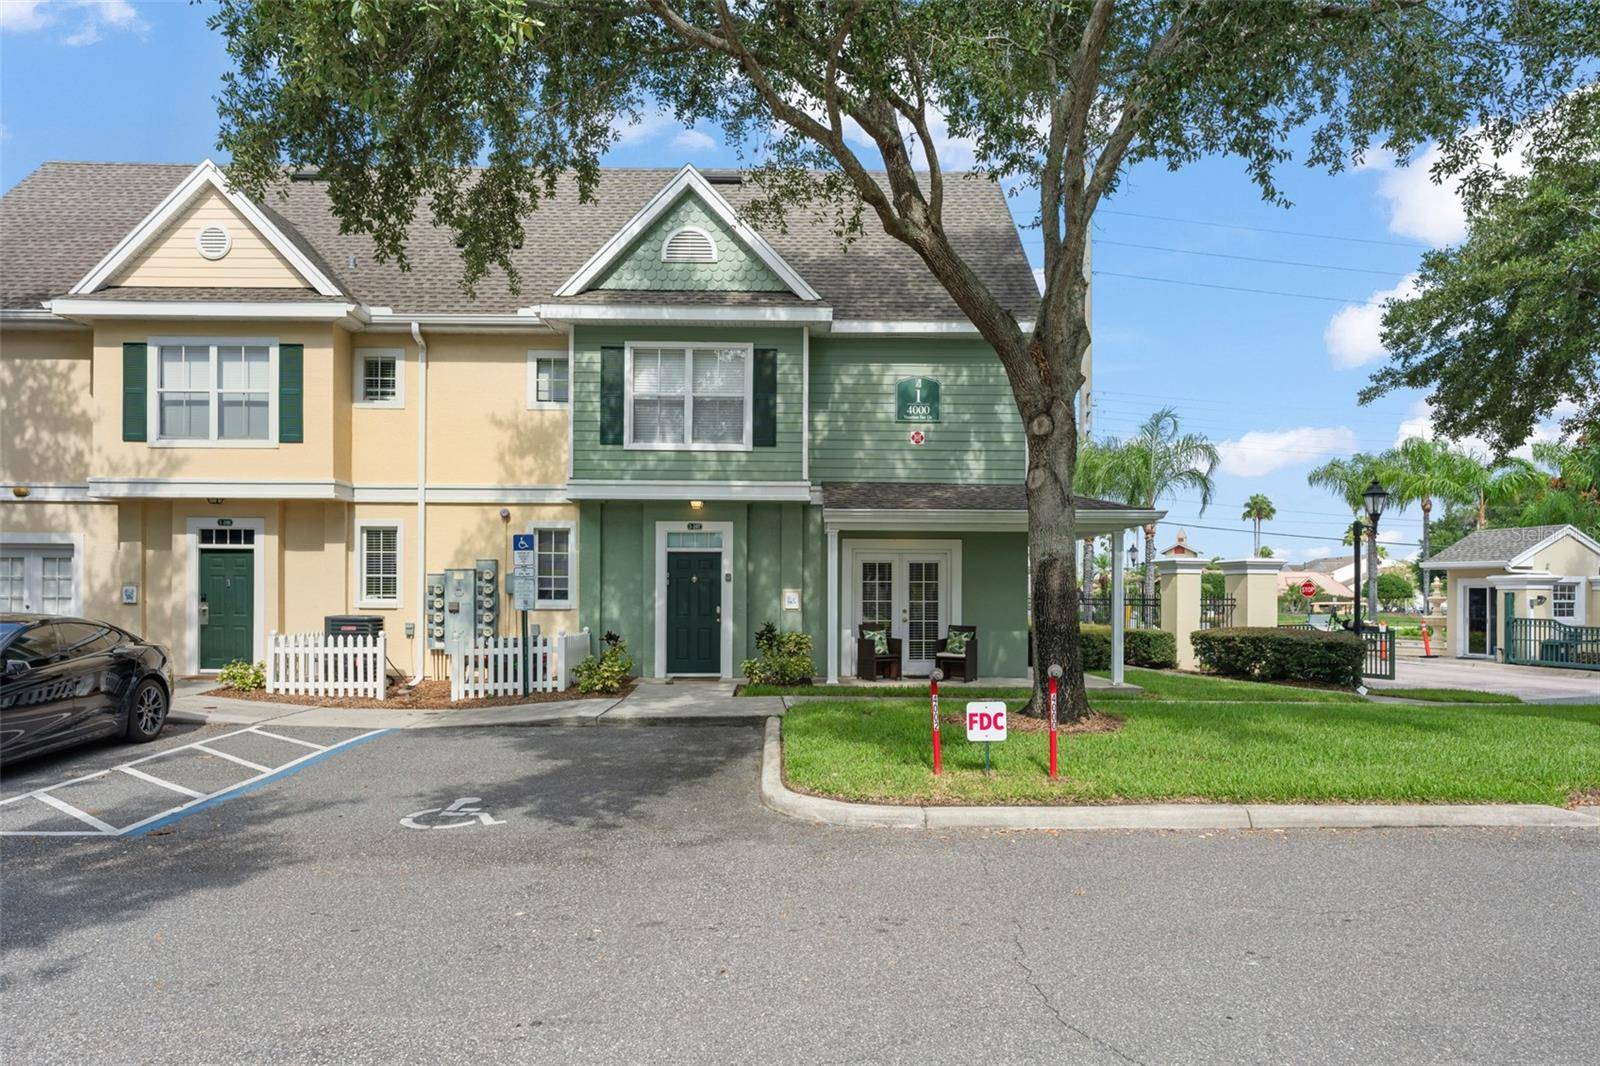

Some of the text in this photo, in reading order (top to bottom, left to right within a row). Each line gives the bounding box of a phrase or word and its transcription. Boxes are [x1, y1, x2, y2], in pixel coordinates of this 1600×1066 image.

[915, 389, 921, 403] 1
[906, 405, 930, 415] 4000
[968, 713, 1004, 731] FDC
